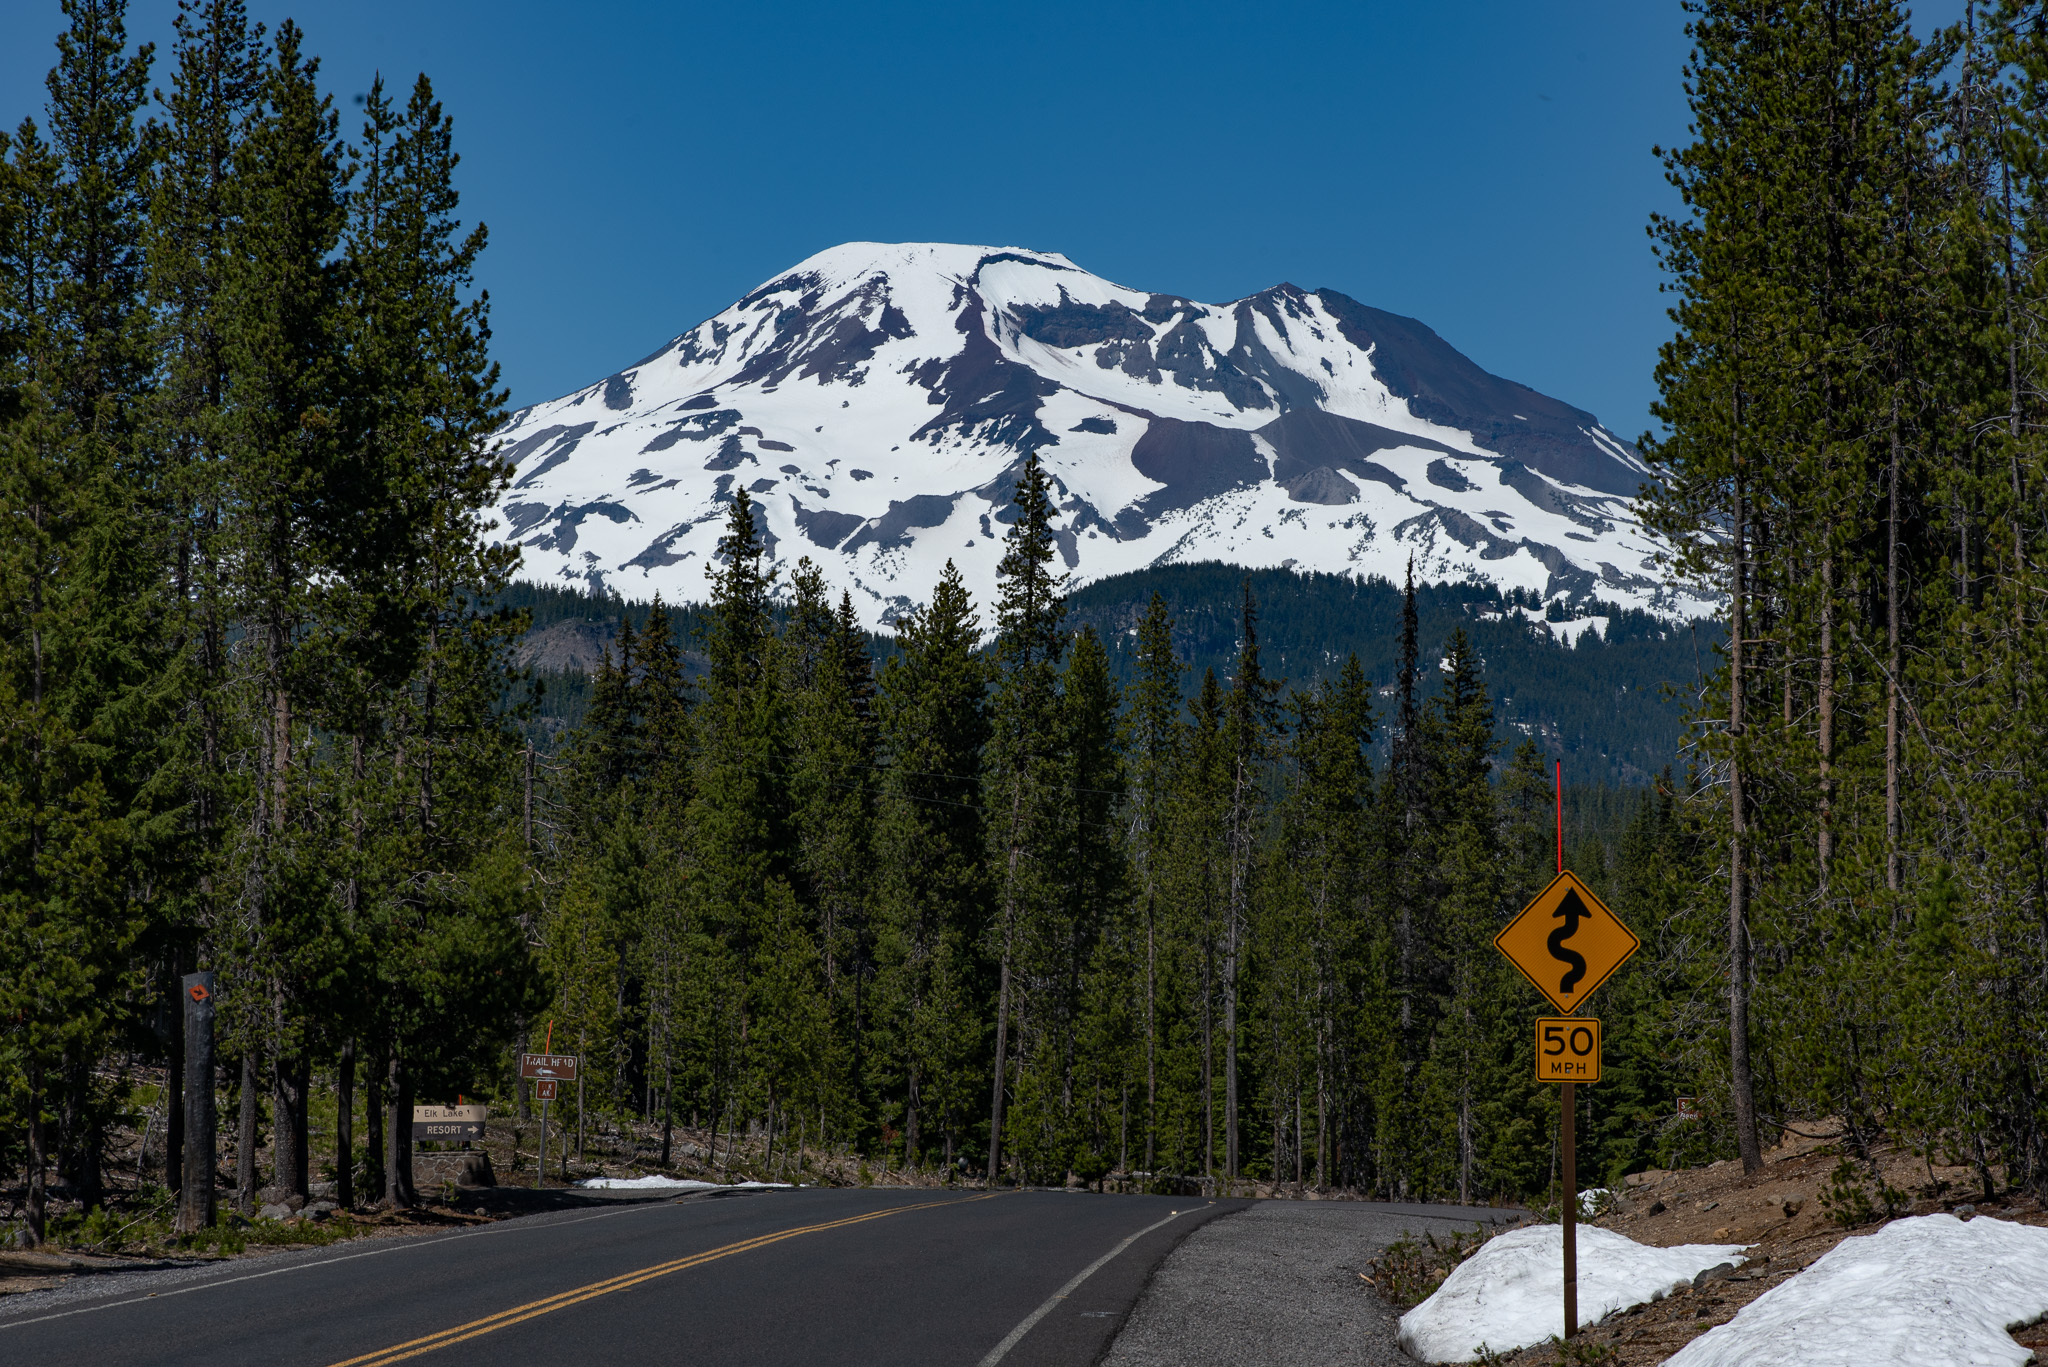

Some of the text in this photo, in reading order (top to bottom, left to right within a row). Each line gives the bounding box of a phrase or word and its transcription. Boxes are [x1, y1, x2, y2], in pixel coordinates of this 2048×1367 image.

[1544, 1026, 1594, 1056] 50
[526, 1056, 549, 1066] TRAIL
[1551, 1062, 1586, 1074] MPH
[424, 1109, 464, 1118] Elk Lake
[427, 1125, 462, 1135] RESORT
